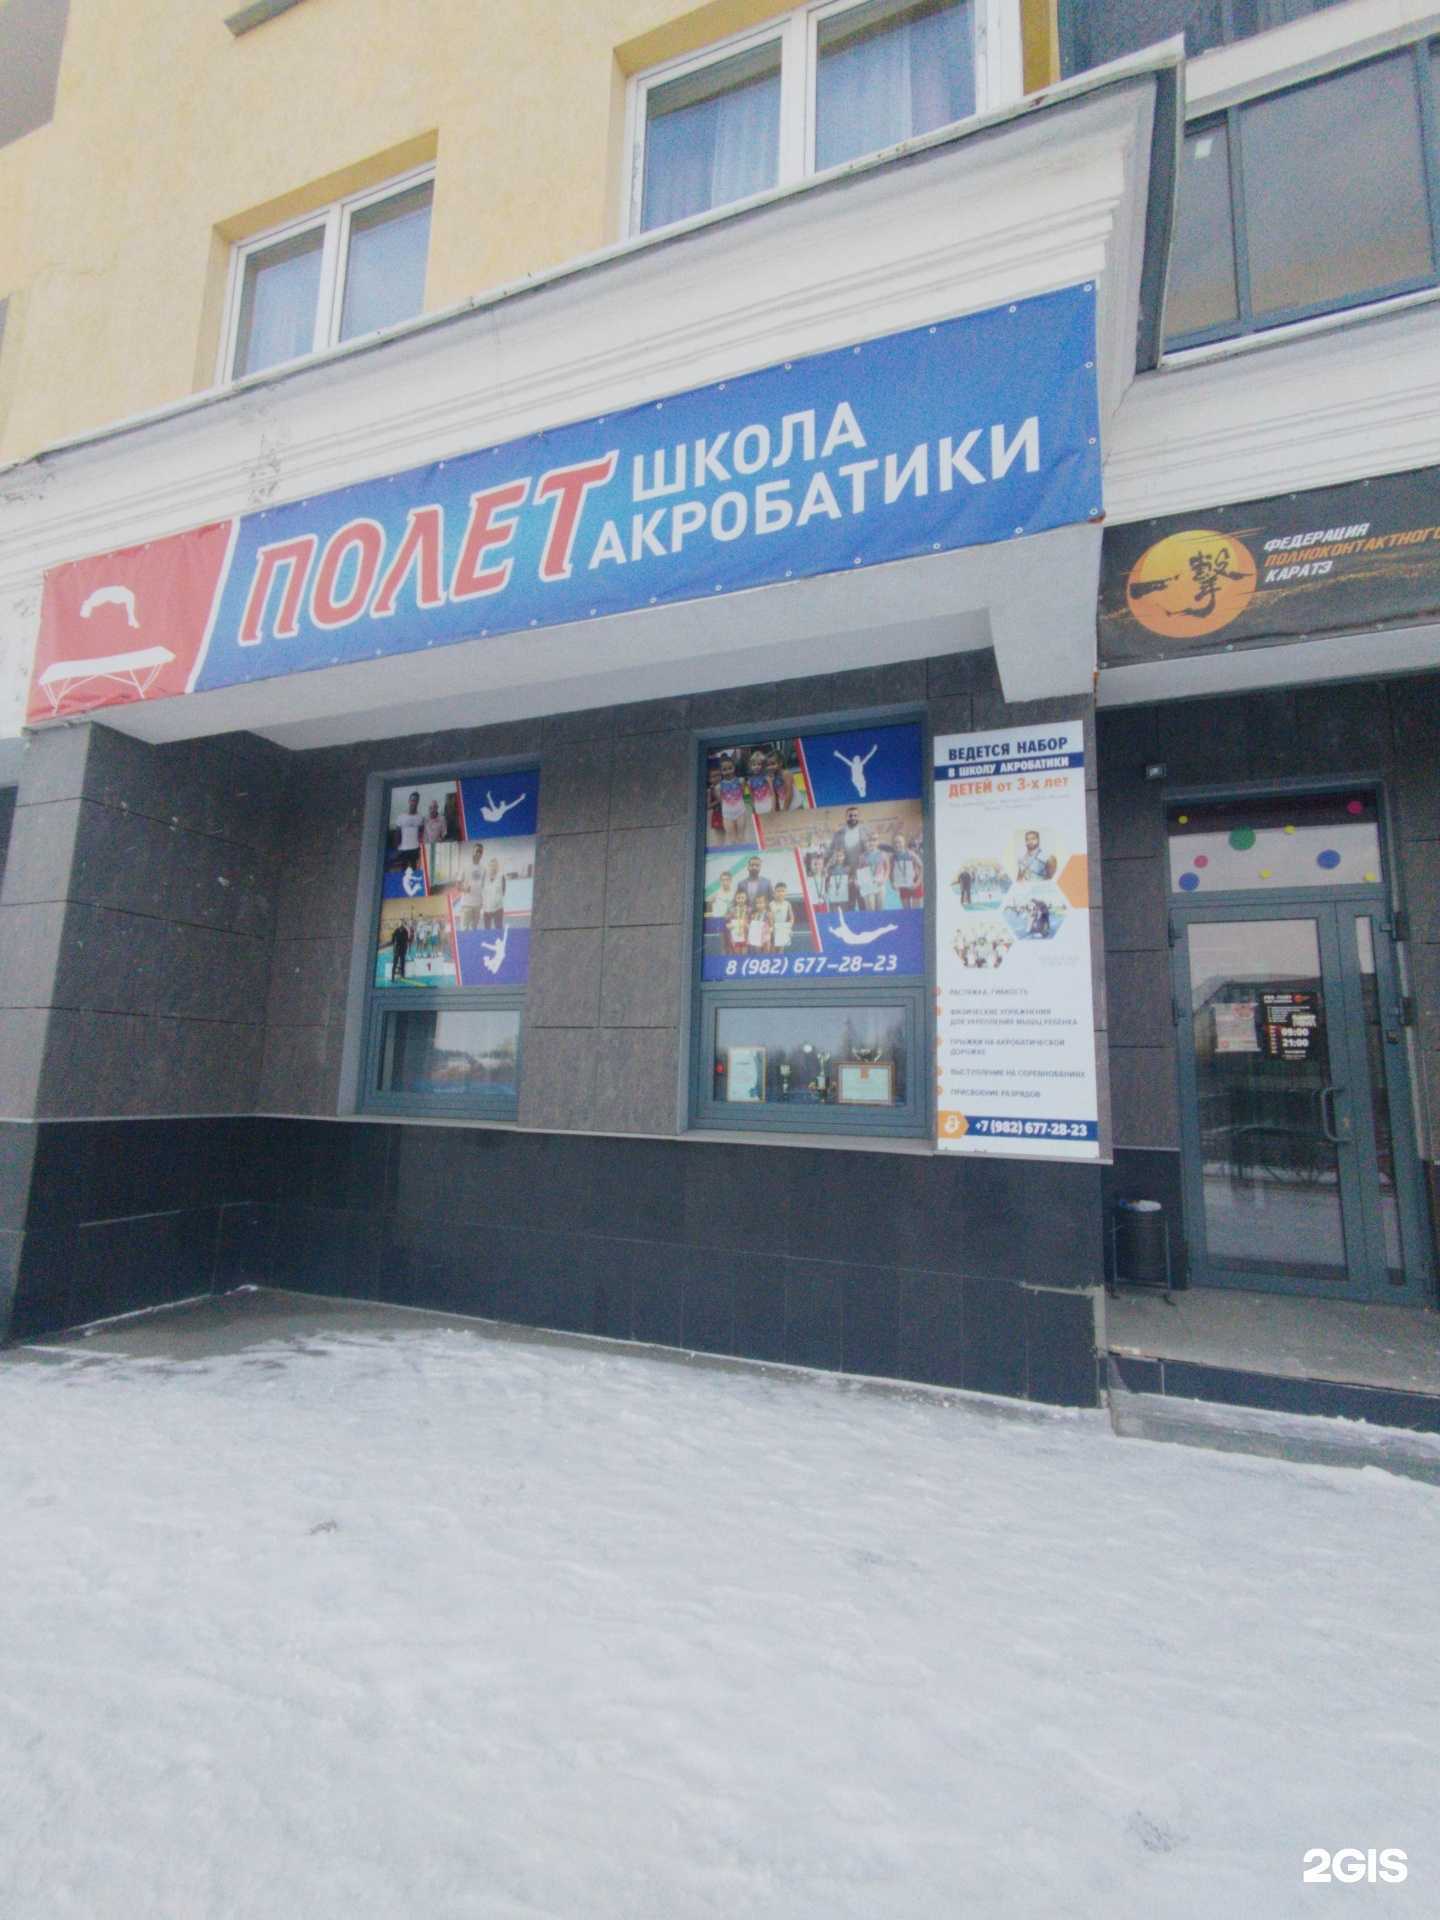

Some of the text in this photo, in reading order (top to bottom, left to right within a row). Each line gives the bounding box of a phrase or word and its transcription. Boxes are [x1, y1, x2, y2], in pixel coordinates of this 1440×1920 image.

[632, 401, 866, 501] ШКОЛА
[588, 415, 1040, 570] АКРОБАТИКИ
[237, 449, 619, 647] ПОЛЕТ
[1264, 523, 1370, 551] ФЕДЕРАЦИЯ
[1265, 560, 1334, 583] КАРАТЭ
[948, 737, 1068, 761] ВЕДЕТСЯ НАБОР
[948, 756, 1069, 778] В ШКОЛУ АКРОБАТИКИ
[948, 778, 993, 799] ДЕТЕЙ
[996, 782, 1012, 793] от
[1017, 775, 1040, 792] 3-х
[1044, 776, 1069, 788] лет
[726, 955, 898, 976] 8 (982) 677-28-23
[975, 1120, 1088, 1137] +7 (982) 677-28-23
